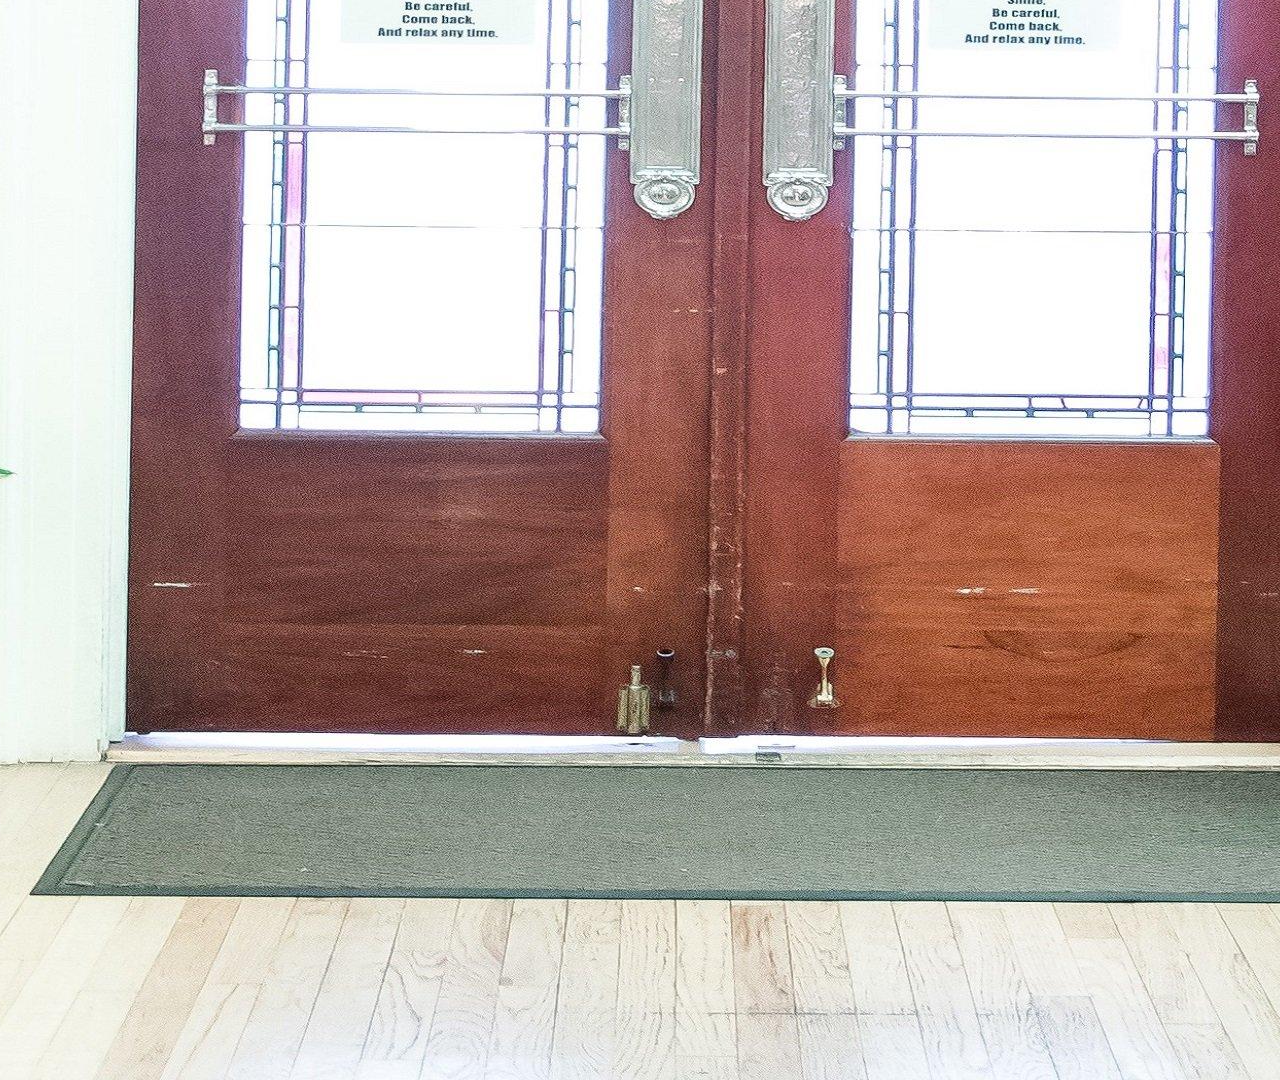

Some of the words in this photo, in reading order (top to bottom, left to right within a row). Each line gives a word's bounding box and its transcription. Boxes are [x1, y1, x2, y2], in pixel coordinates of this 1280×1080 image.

[404, 1, 421, 11] Be
[423, 1, 474, 12] careful.
[991, 7, 1008, 18] Be
[1011, 8, 1060, 19] careful.
[401, 14, 439, 25] Come
[441, 14, 476, 25] back.
[989, 21, 1026, 31] Come
[1028, 21, 1063, 32] back.
[376, 27, 403, 37] And
[404, 27, 438, 38] relax
[440, 29, 464, 39] any
[466, 28, 499, 38] time.
[964, 33, 990, 44] And
[992, 34, 1025, 44] relax
[1027, 36, 1052, 46] any
[1054, 35, 1086, 45] time.
